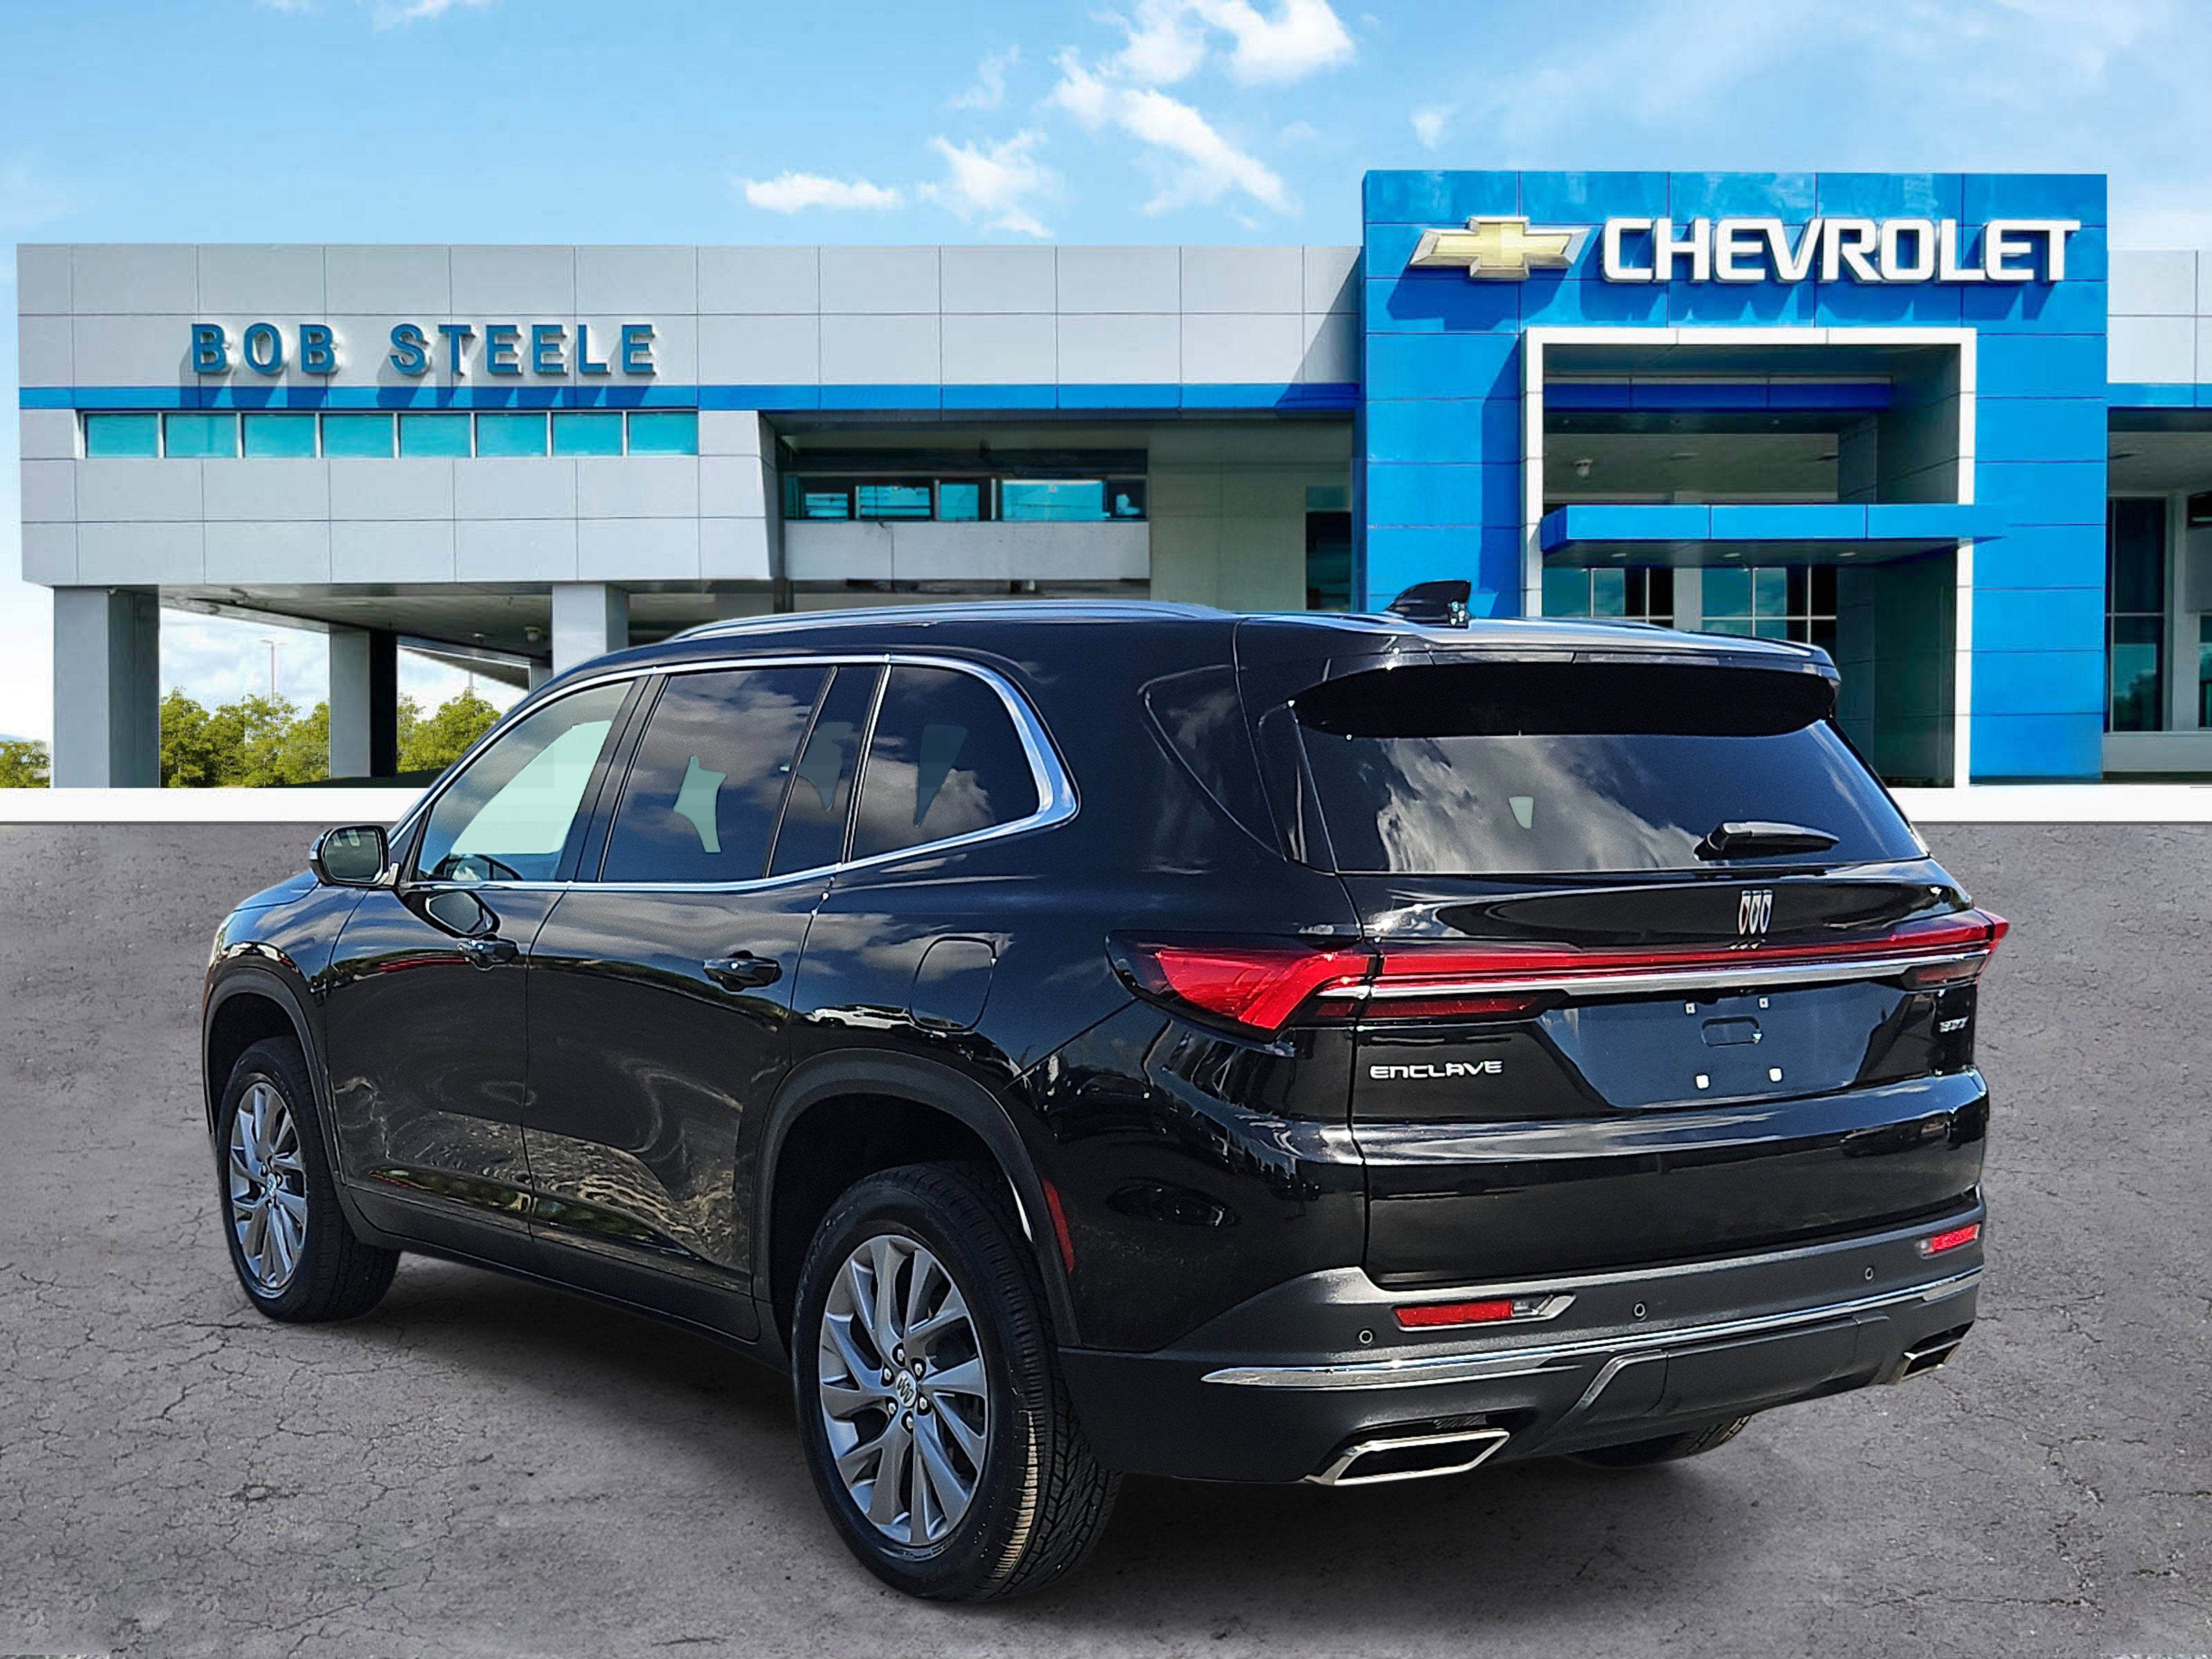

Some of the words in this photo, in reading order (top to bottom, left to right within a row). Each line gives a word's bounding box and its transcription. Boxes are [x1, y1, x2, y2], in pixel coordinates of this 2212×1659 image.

[1603, 217, 2081, 281] CHEVROLET
[191, 322, 338, 375] BOB
[390, 323, 656, 376] STEELE
[1370, 1060, 1503, 1080] ENCLAVE
